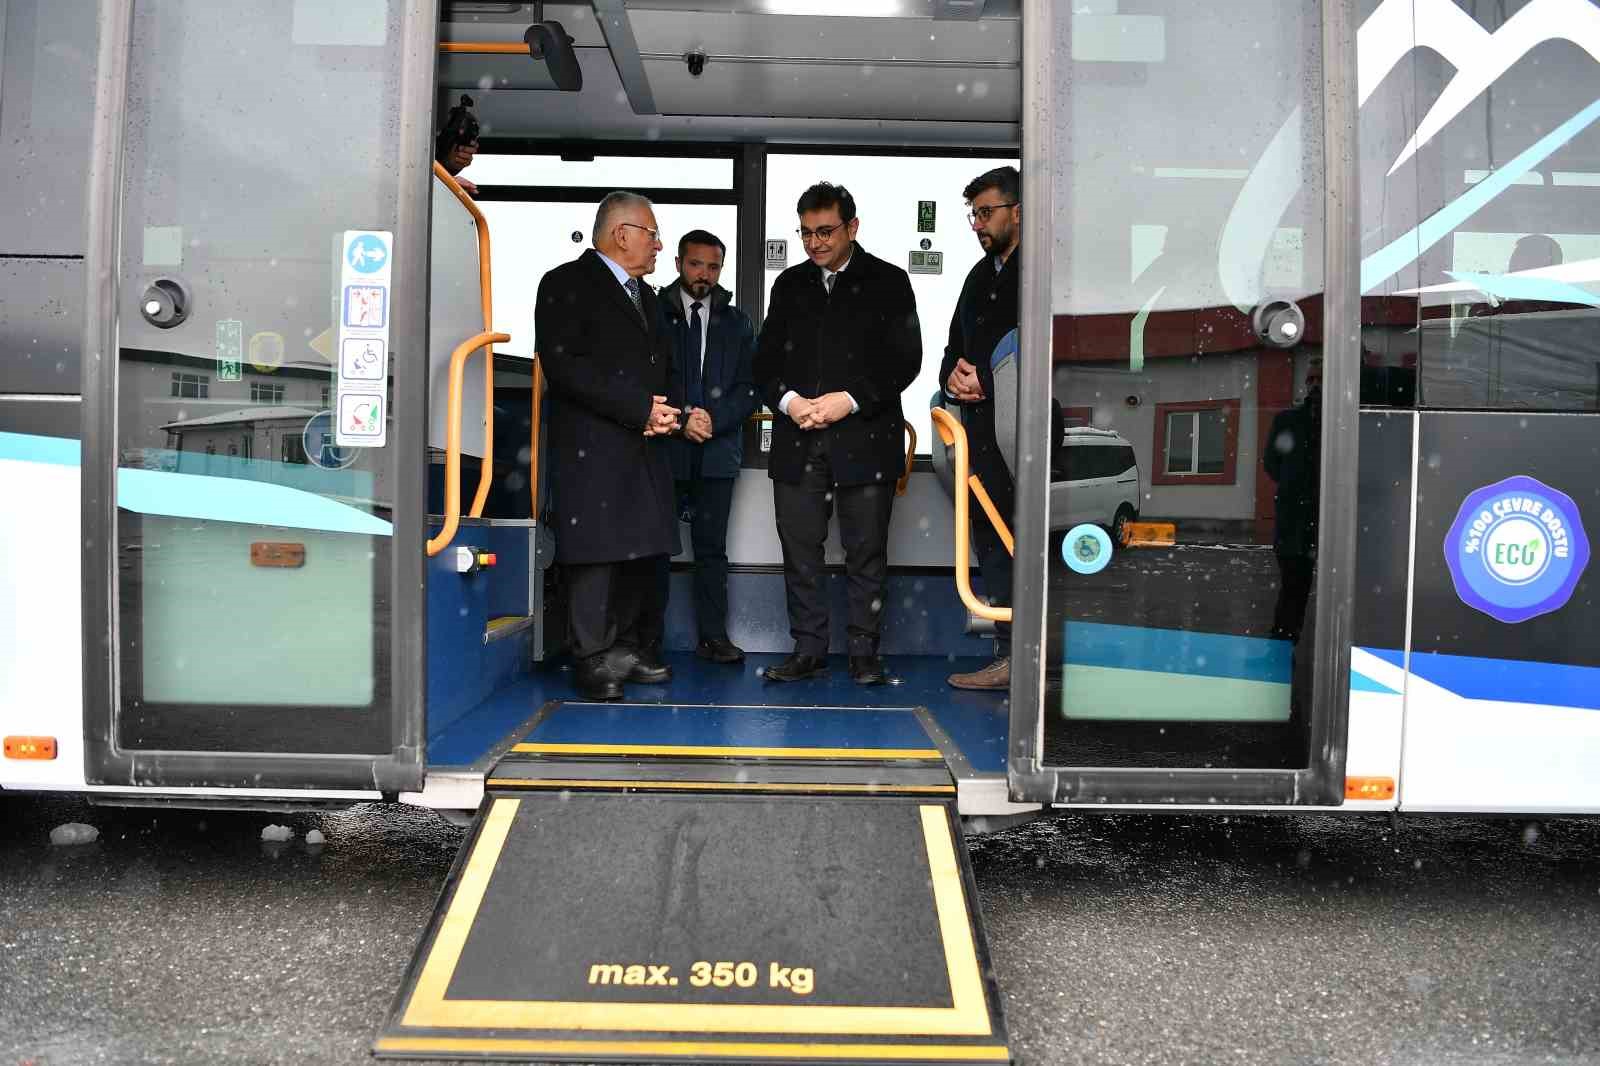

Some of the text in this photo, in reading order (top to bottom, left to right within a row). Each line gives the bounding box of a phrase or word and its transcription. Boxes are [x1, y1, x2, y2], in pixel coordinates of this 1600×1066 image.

[1465, 497, 1569, 558] %100 ÇEVRE DOSTU
[587, 961, 814, 994] max. 350 kg
